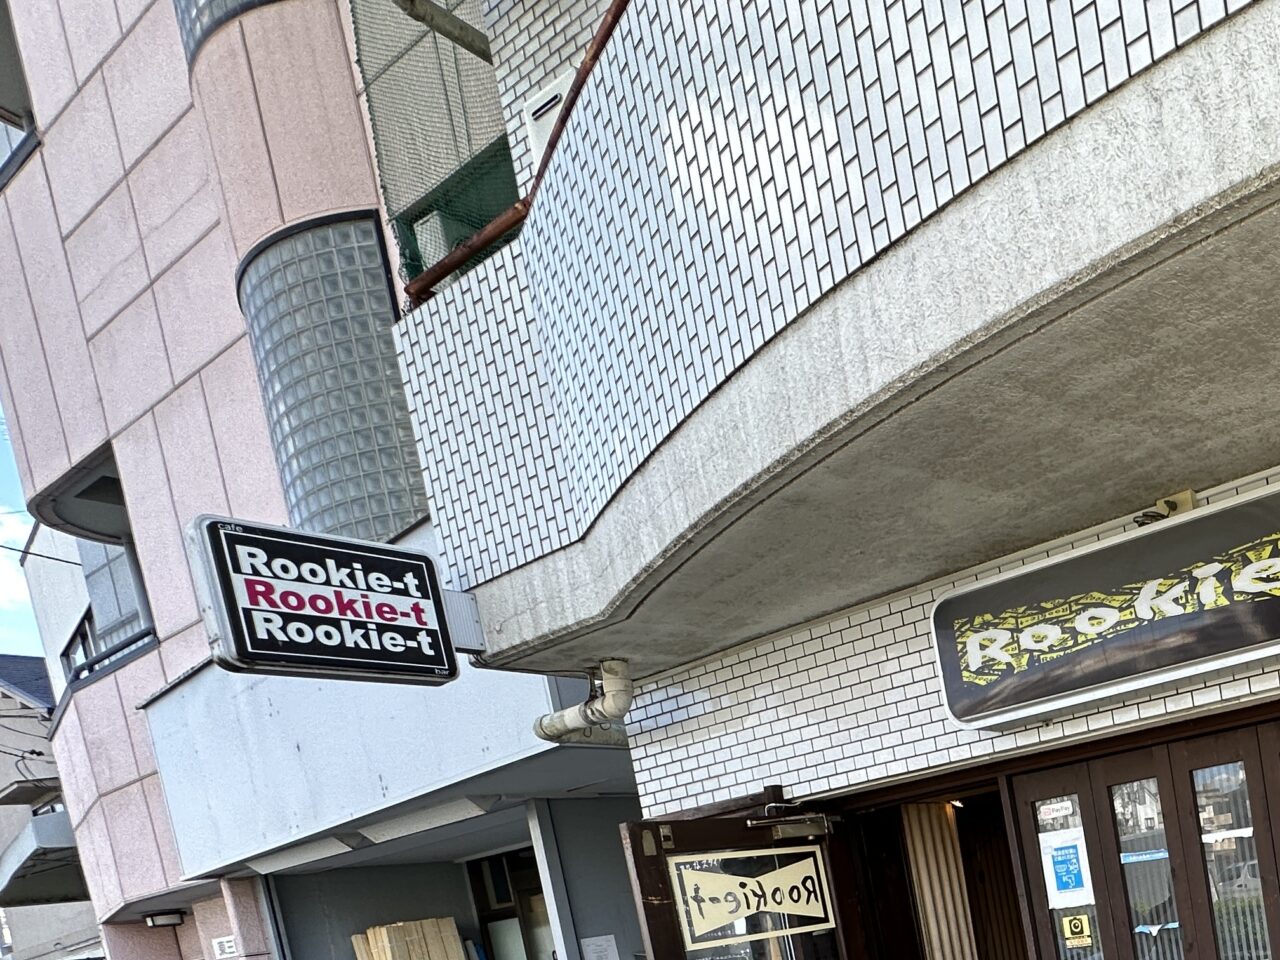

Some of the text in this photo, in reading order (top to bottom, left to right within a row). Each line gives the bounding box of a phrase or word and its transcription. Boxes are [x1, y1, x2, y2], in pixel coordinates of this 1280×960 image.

[217, 522, 244, 533] cafe
[234, 543, 423, 598] Rookie-t
[243, 577, 428, 626] Rookie-t
[250, 609, 436, 656] Rookie-t
[434, 667, 451, 676] bar
[1051, 806, 1070, 814] PayPay
